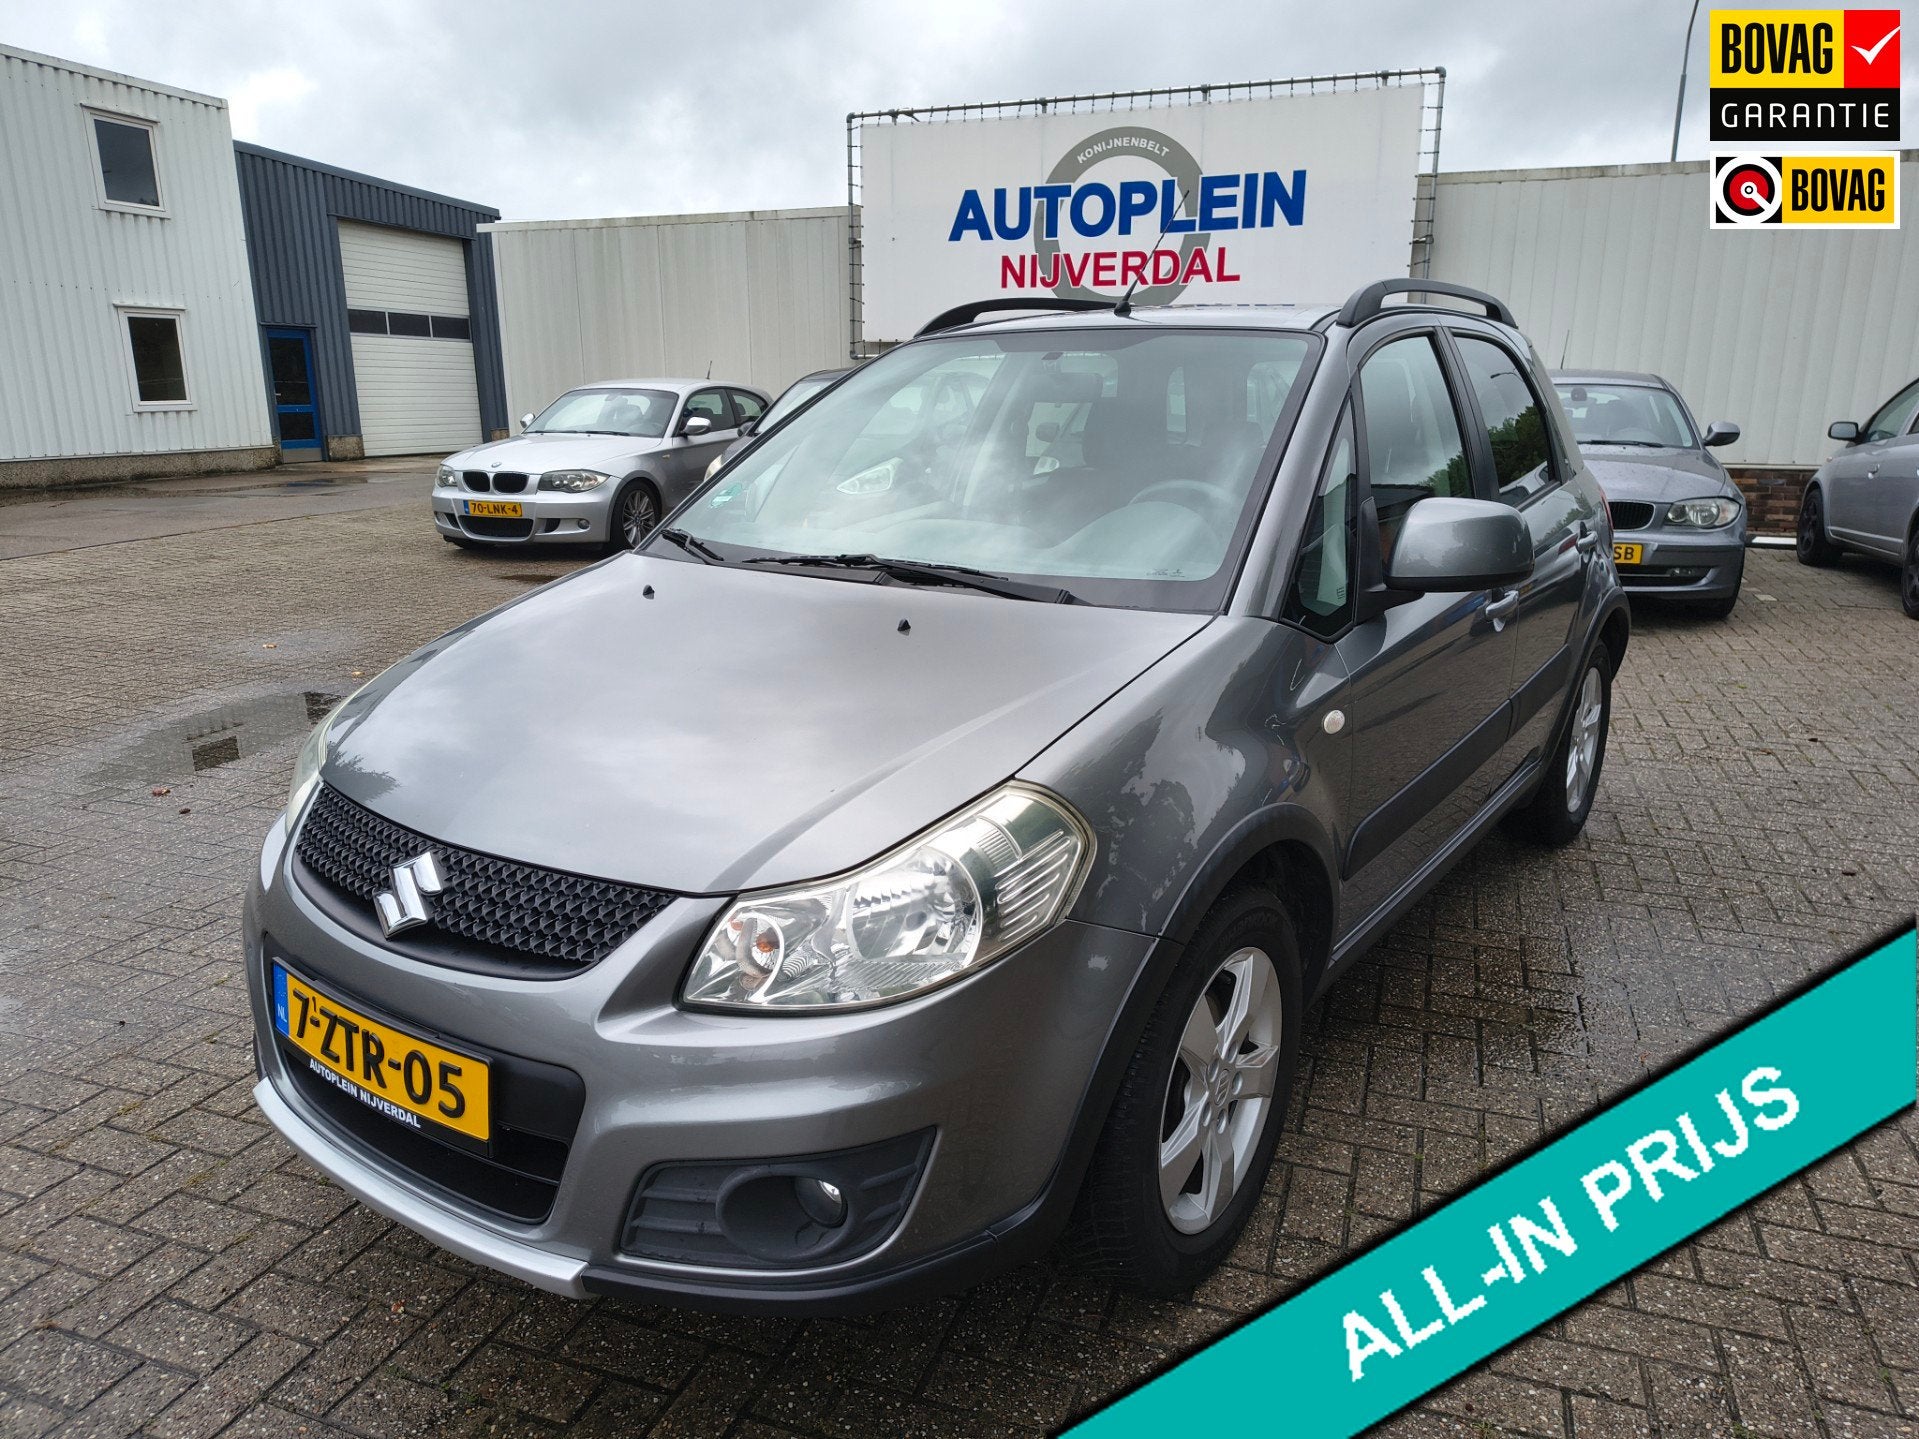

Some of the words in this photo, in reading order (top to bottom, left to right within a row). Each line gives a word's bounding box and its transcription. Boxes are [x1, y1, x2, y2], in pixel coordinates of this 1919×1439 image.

[1076, 136, 1170, 163] KONIJNENBELT
[948, 169, 1308, 242] AUTOPLEIN
[1000, 246, 1241, 289] NIJVERDAL
[471, 502, 519, 515] 70-LNK-4
[292, 987, 466, 1119] 7-ZTR-05
[309, 1058, 358, 1098] AUTOPLEIN
[360, 1089, 422, 1128] NIJVERDAL
